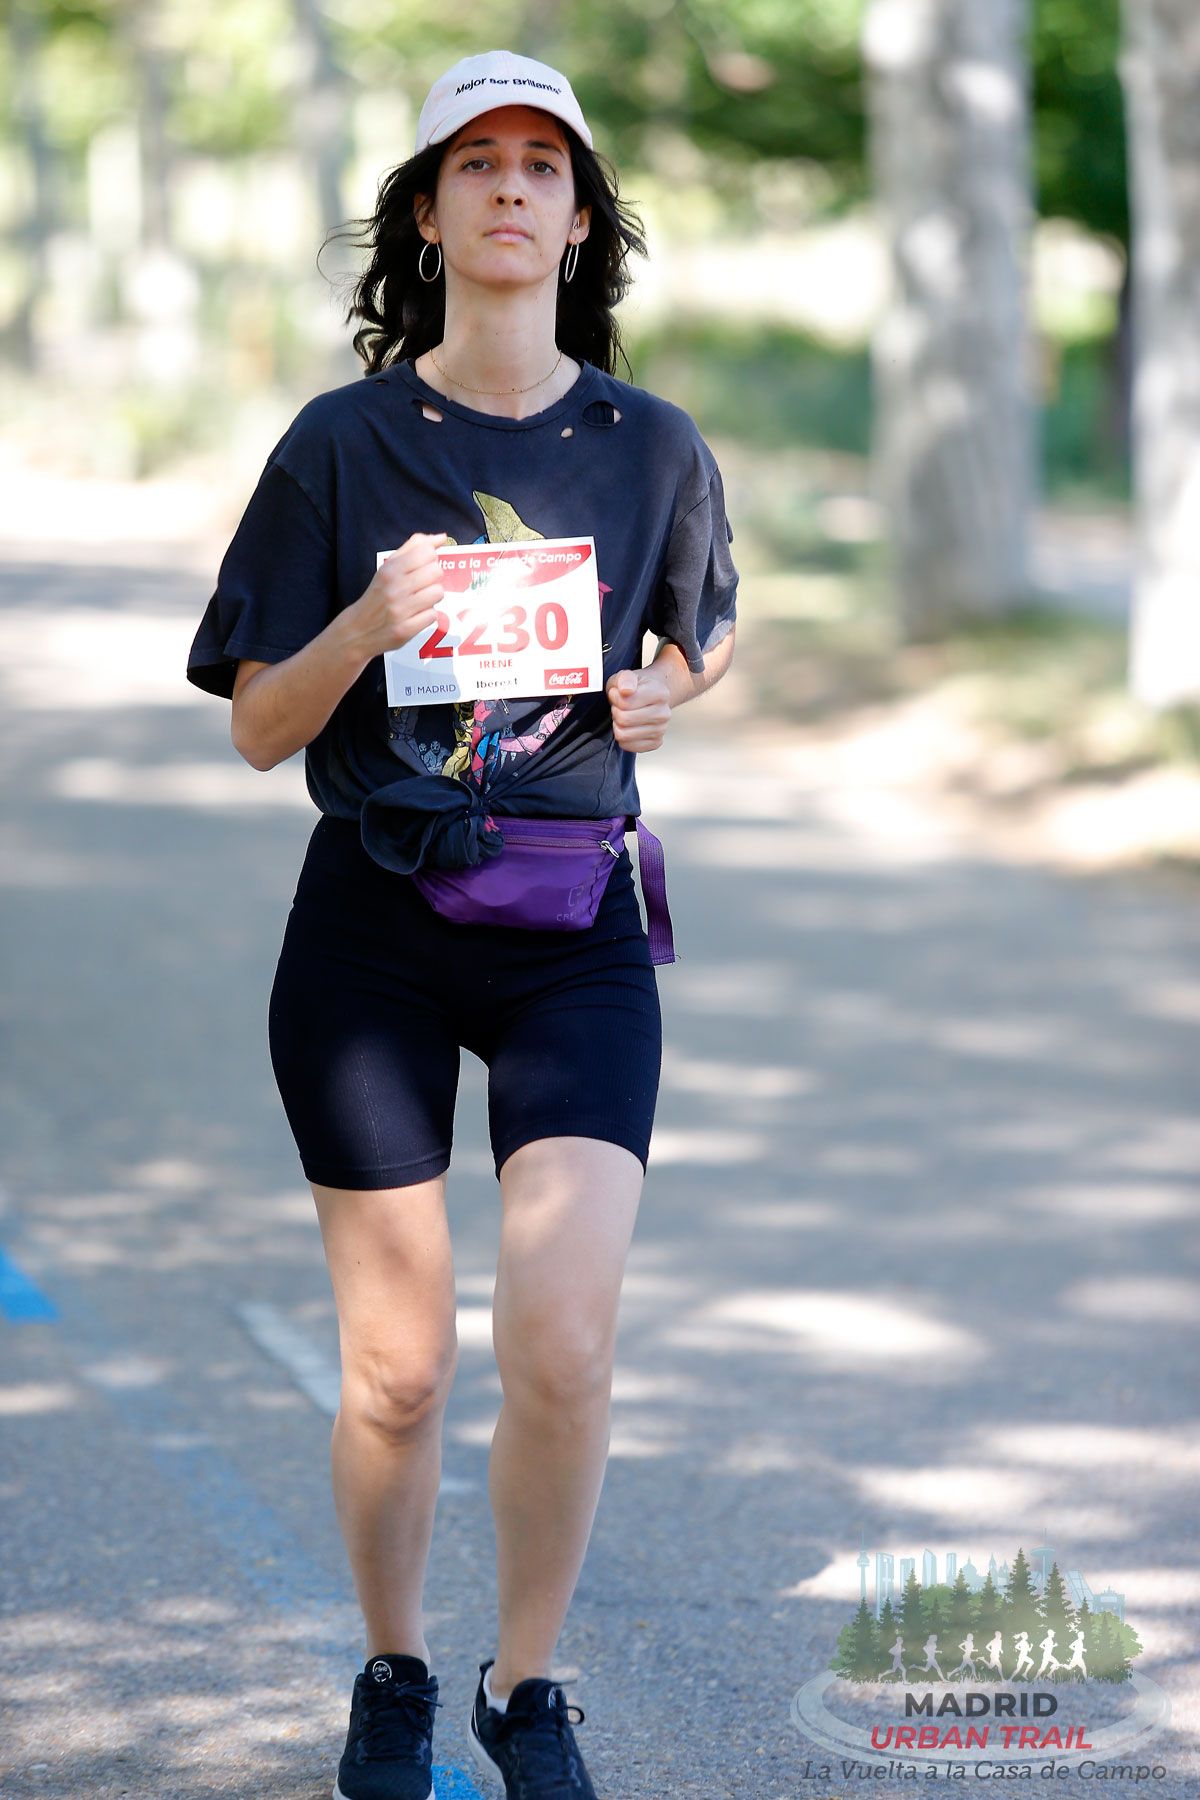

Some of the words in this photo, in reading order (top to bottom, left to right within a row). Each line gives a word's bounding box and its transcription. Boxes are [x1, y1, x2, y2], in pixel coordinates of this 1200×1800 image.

[455, 78, 487, 96] Mejor
[458, 560, 467, 569] a
[469, 557, 481, 569] la
[538, 552, 582, 565] Campo
[418, 602, 569, 660] 2230
[479, 659, 514, 669] IRENE
[417, 684, 457, 695] MADRID
